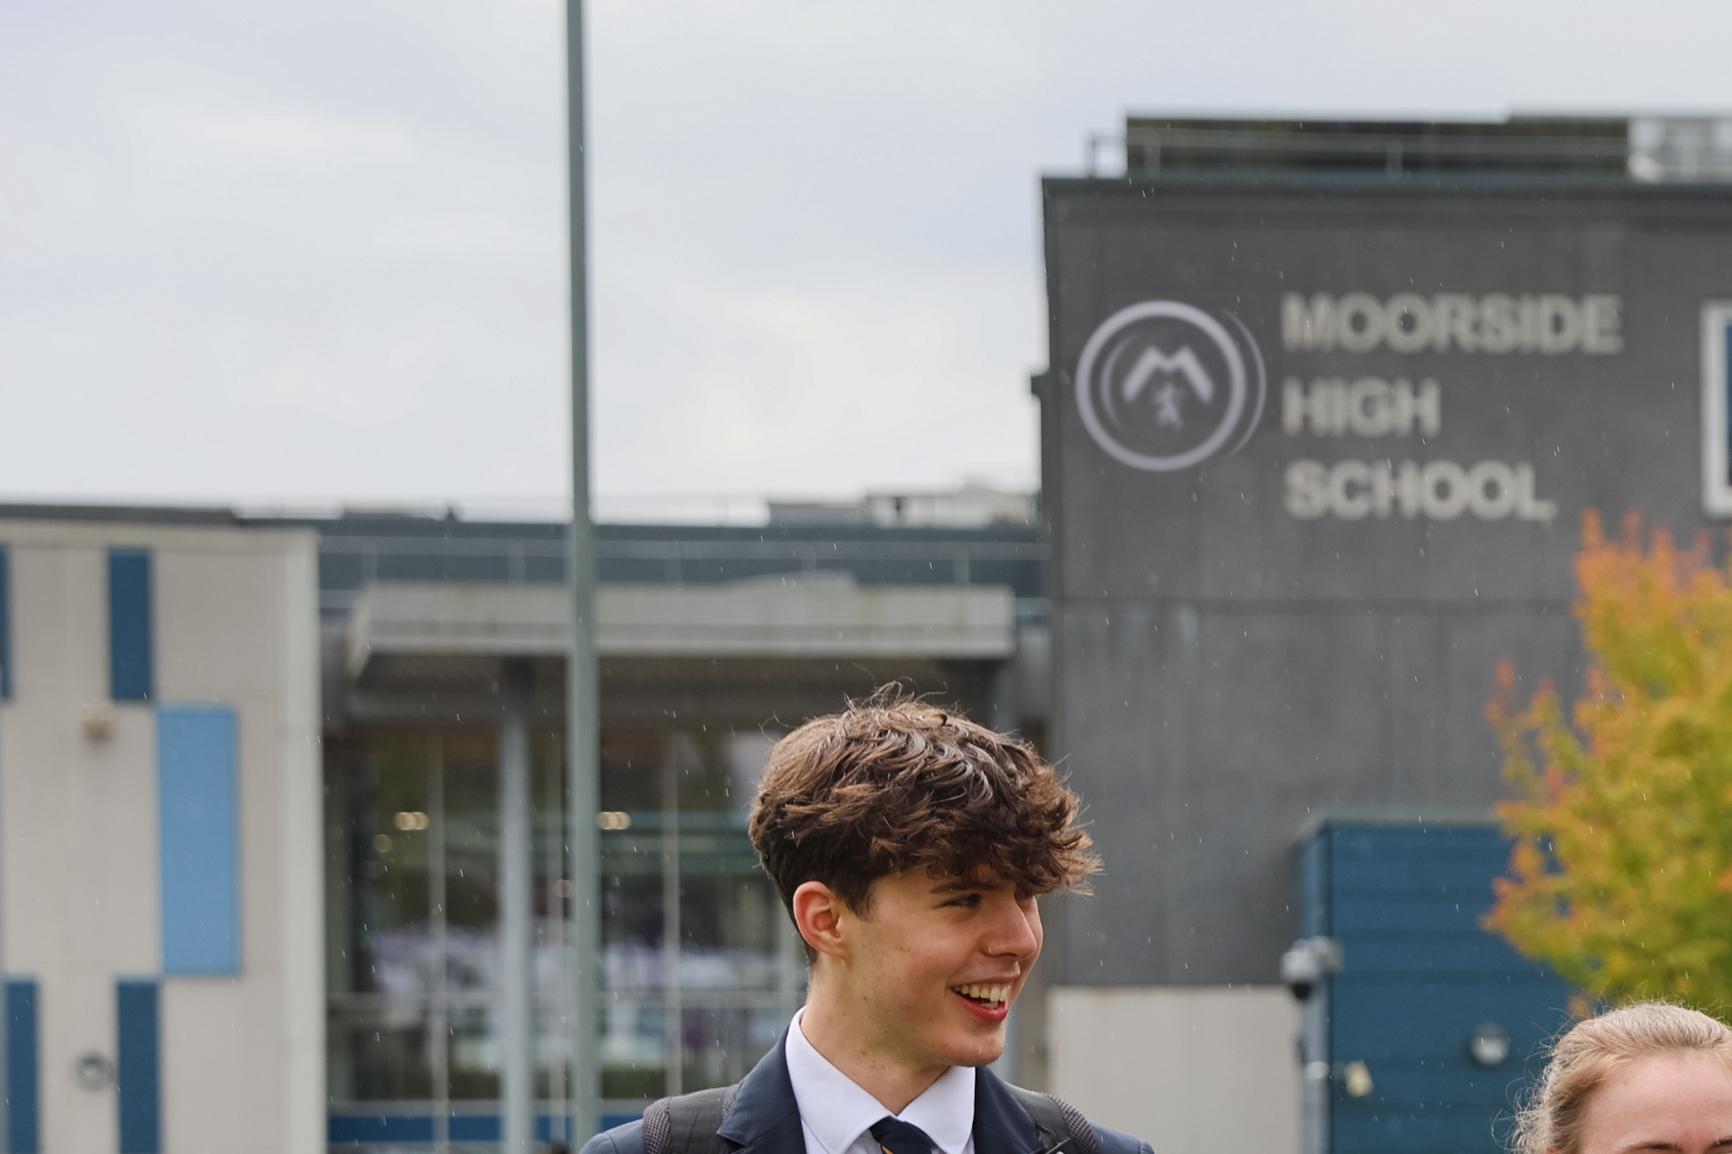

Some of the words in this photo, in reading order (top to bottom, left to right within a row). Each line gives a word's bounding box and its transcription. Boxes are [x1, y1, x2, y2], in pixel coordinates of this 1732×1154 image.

[1282, 293, 1624, 354] MOORSIDE
[1282, 378, 1441, 437] HIGH
[1284, 459, 1558, 520] SCHOOL
